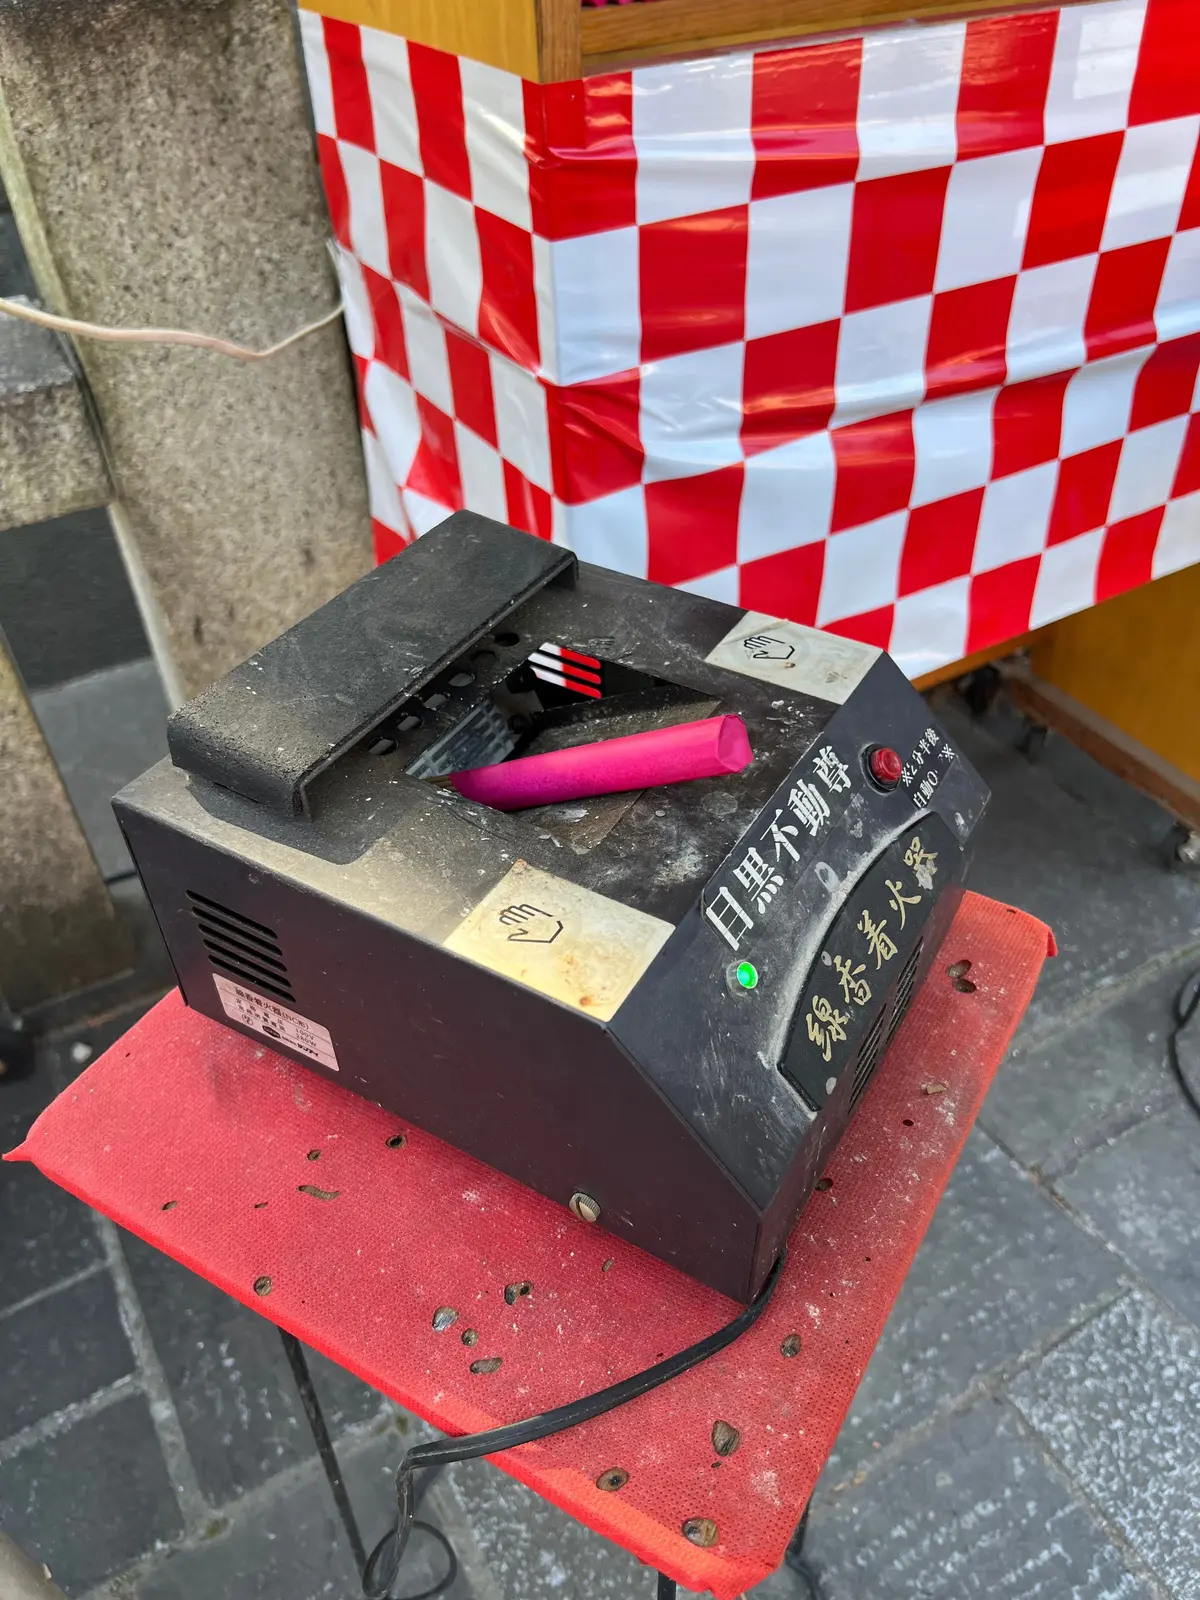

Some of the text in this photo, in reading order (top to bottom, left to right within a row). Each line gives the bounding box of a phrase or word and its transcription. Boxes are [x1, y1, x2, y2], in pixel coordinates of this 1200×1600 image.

[705, 745, 852, 951] 目黒不動尊
